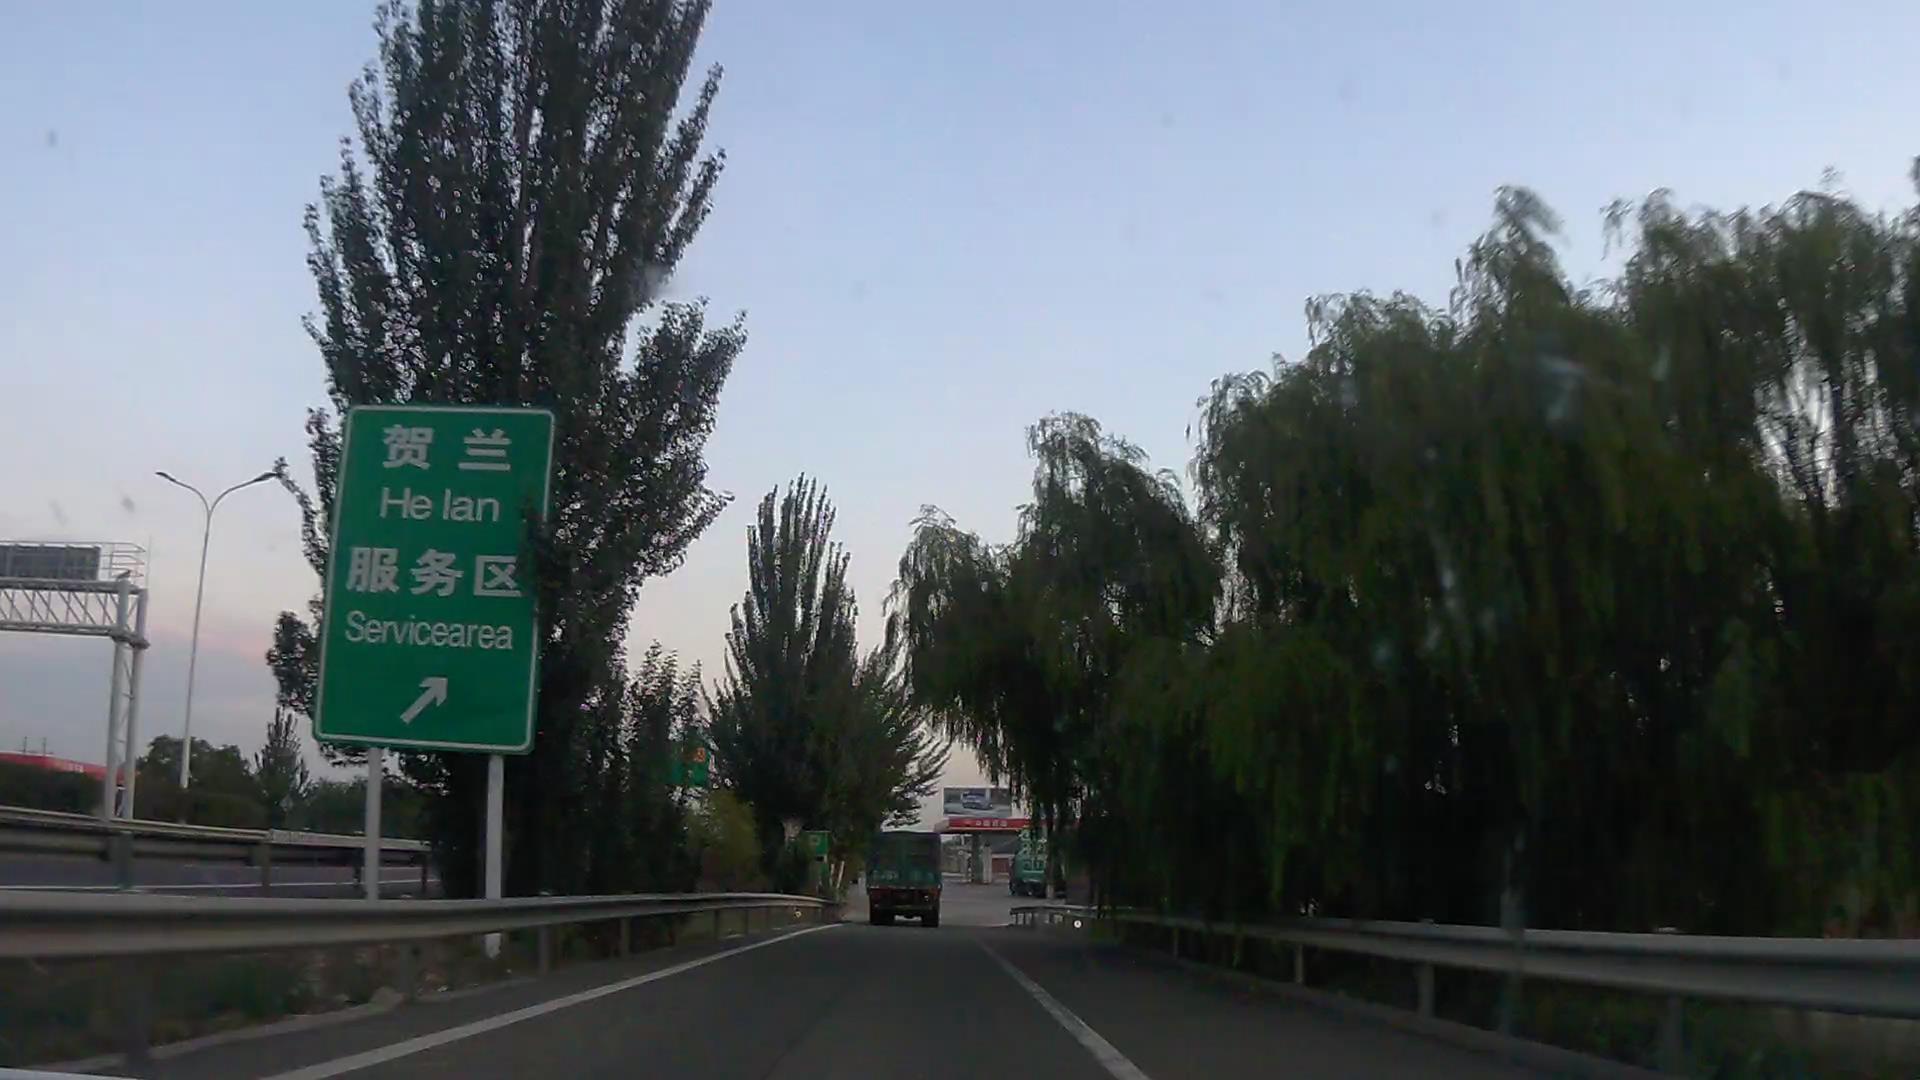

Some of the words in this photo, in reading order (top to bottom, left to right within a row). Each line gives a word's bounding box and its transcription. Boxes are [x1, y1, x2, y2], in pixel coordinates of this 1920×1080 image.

[382, 424, 511, 471] 贺兰
[380, 487, 433, 520] He
[443, 489, 500, 522] lan
[346, 547, 523, 598] 服务区
[345, 610, 514, 650] Servicearea
